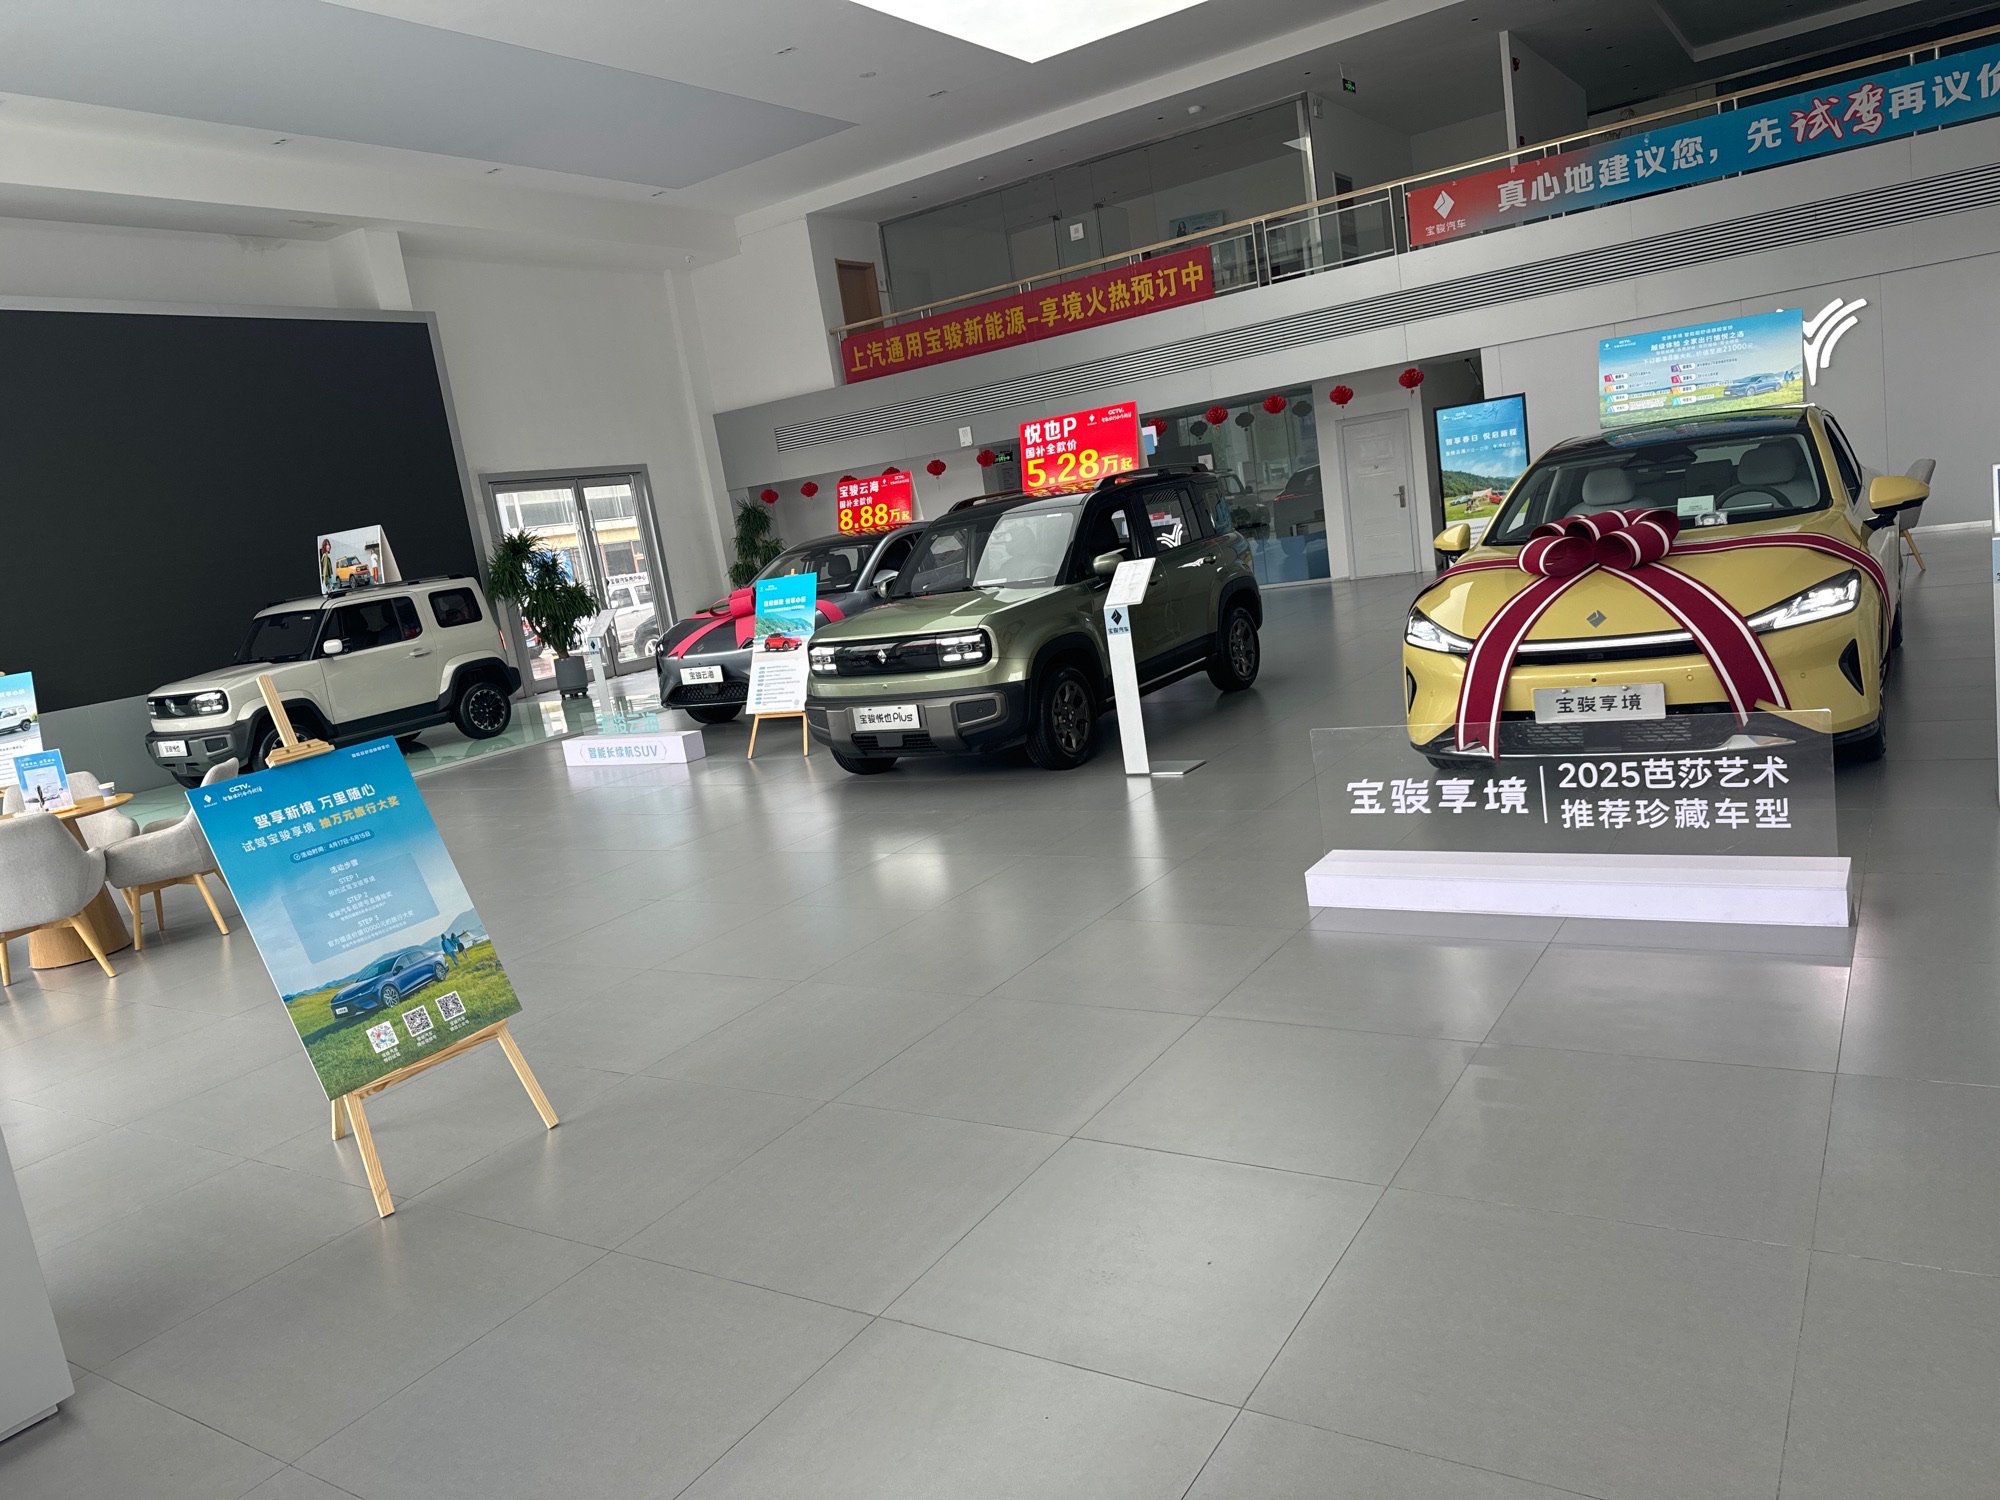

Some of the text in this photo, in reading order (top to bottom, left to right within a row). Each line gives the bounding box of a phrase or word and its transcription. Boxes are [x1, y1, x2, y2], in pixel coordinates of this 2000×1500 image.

[1425, 218, 1467, 237] 宝骏汽车
[850, 260, 1204, 373] 上汽通用宝骏新能源-享境火热预订中
[1024, 417, 1077, 446] 悦也P
[1025, 439, 1077, 459] 国补全款价
[1027, 449, 1133, 487] 5.28万起
[839, 481, 879, 498] 宝骏云海
[839, 496, 873, 509] 国补全款价
[840, 503, 910, 530] 8.88万起
[1555, 693, 1642, 714] 宝骏享境
[859, 712, 913, 724] 宝骏悦也Plus
[588, 744, 658, 759] 智能长续航SUV
[1558, 756, 1789, 790] 2025芭莎艺术
[228, 783, 251, 793] CCTV
[1346, 776, 1530, 815] 宝骏享境
[253, 783, 376, 829] 驾享新境 万里随心
[1561, 798, 1793, 829] 推荐珍藏车型
[242, 795, 400, 853] 试驾宝骏享境 抽万元旅行大奖
[329, 858, 359, 874] 活动步骤
[338, 875, 354, 885] STEP
[346, 894, 363, 904] STEP
[357, 917, 374, 928] STEP
